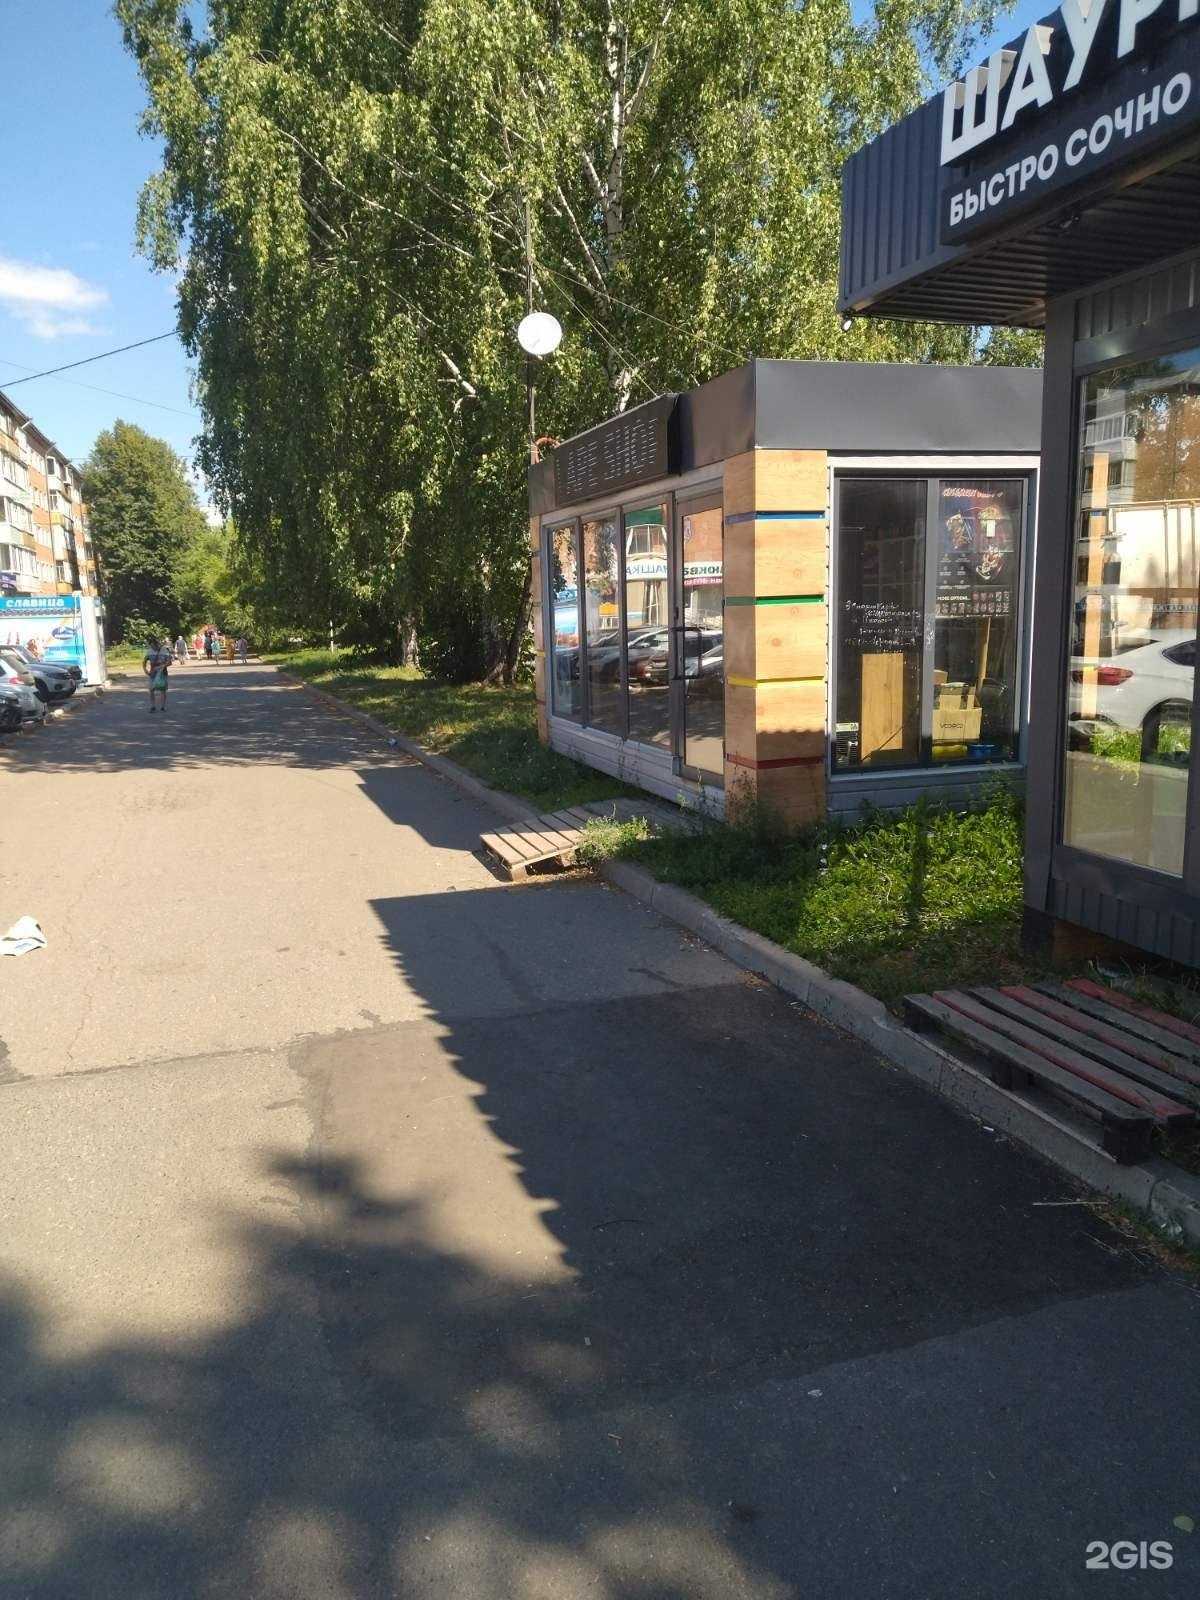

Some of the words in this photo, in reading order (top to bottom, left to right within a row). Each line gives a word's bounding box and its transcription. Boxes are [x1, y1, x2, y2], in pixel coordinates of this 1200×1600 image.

[940, 0, 1200, 166] ШАУР
[949, 144, 1059, 227] БЫСТРО
[1065, 72, 1192, 167] СОЧНО
